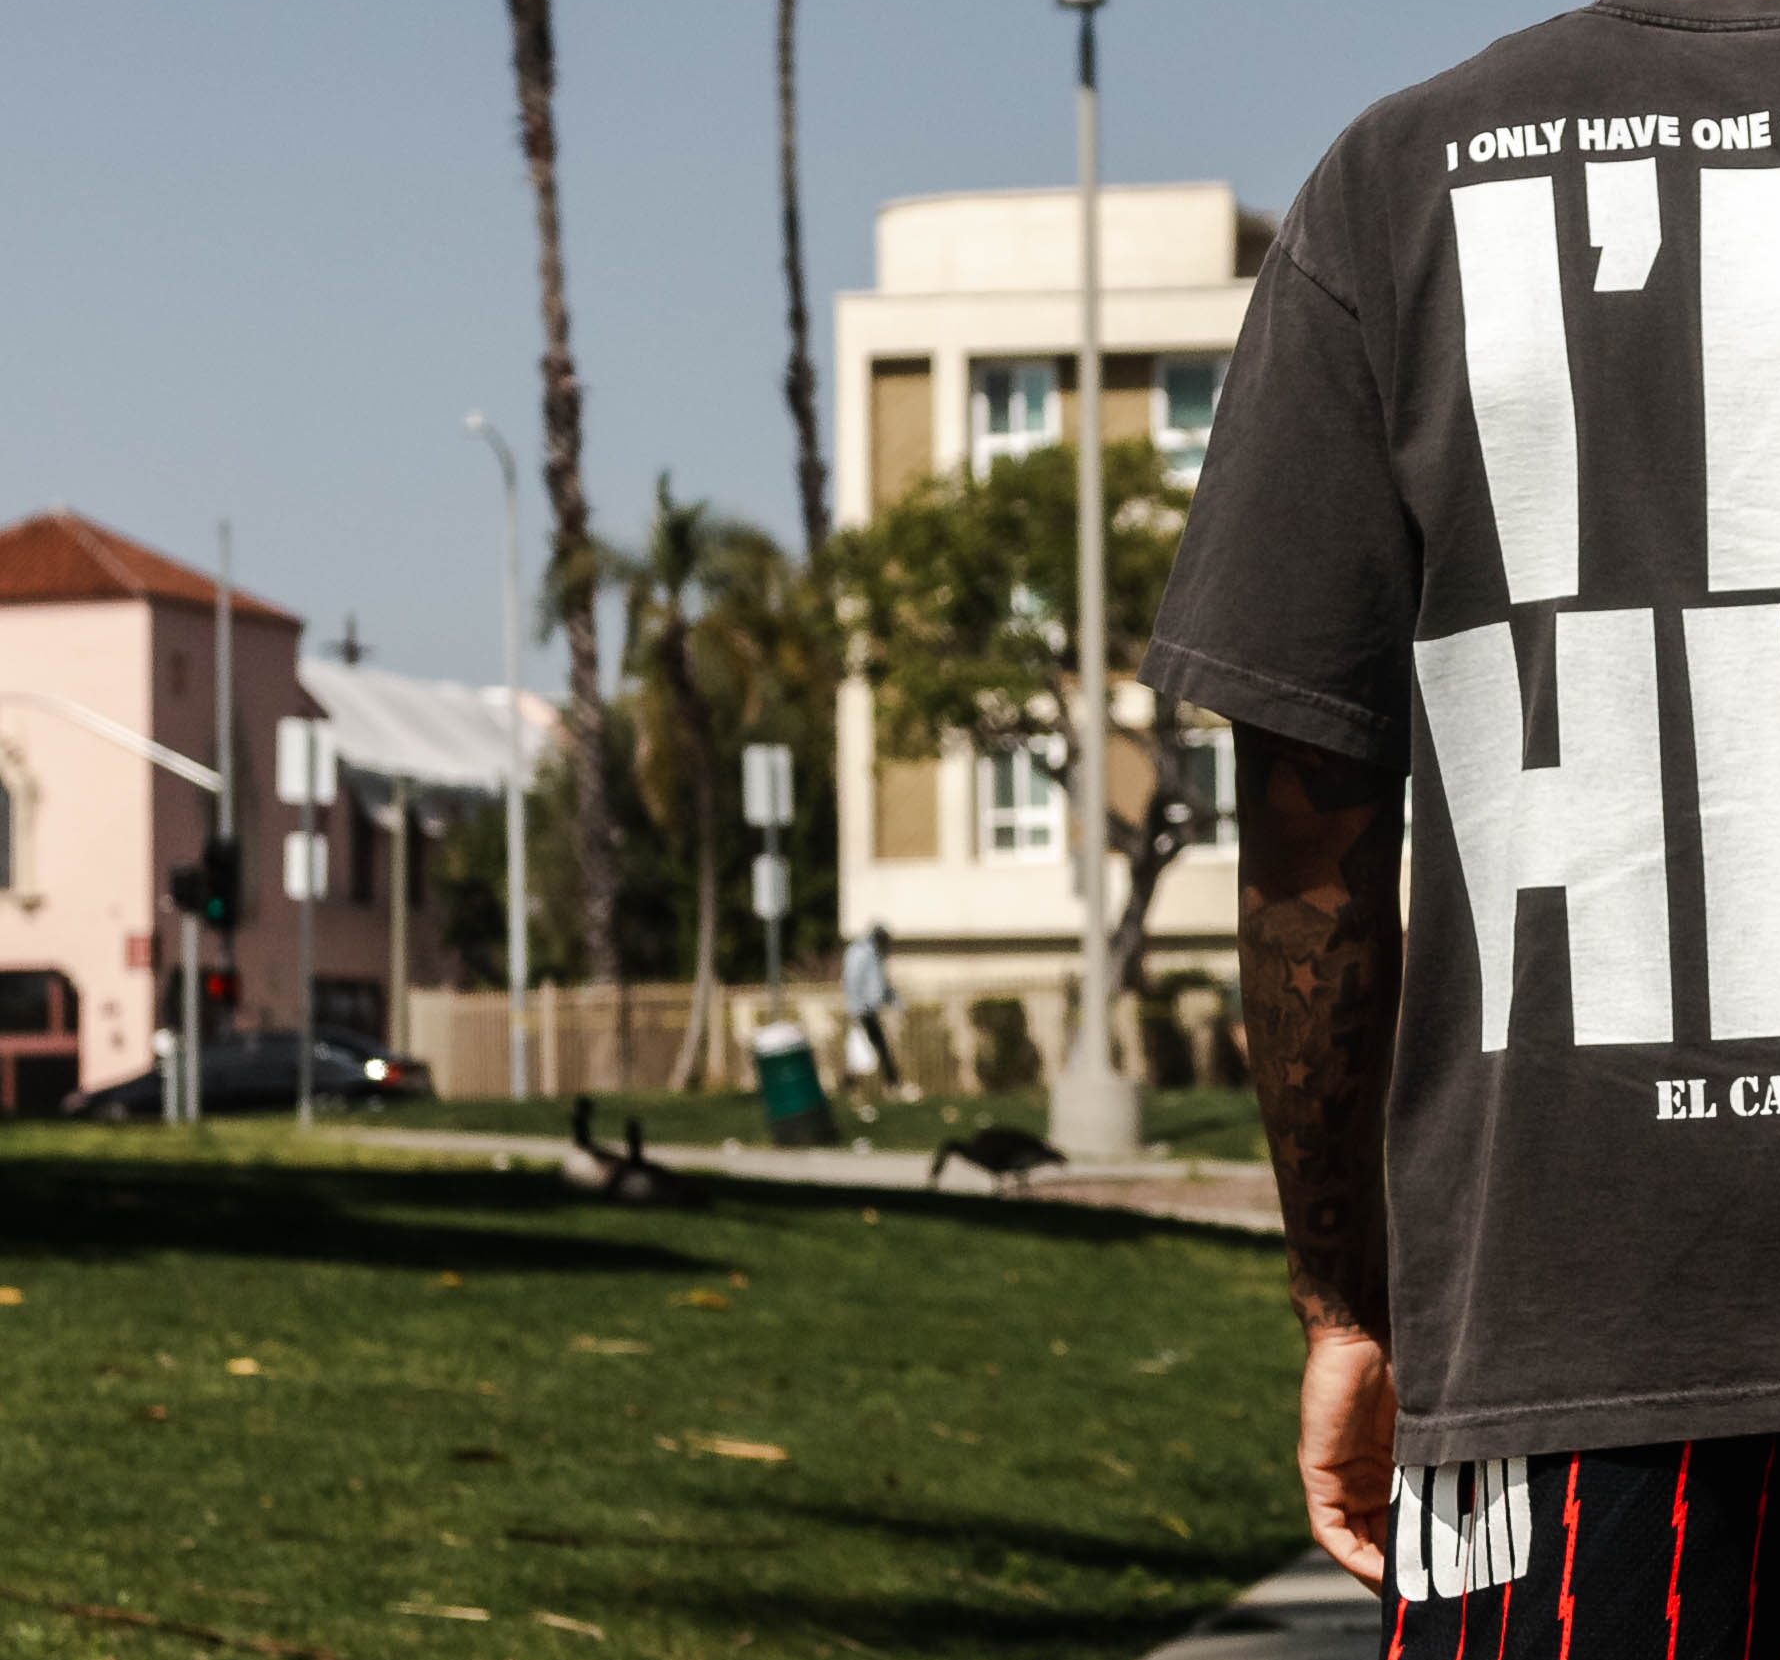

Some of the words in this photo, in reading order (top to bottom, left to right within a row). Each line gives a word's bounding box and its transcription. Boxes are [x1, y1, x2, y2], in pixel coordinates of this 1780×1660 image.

[1446, 141, 1459, 172] I
[1468, 117, 1567, 163] ONLY
[1577, 114, 1681, 151] HAVE
[1691, 110, 1772, 150] ONE
[1655, 1079, 1718, 1120] EL
